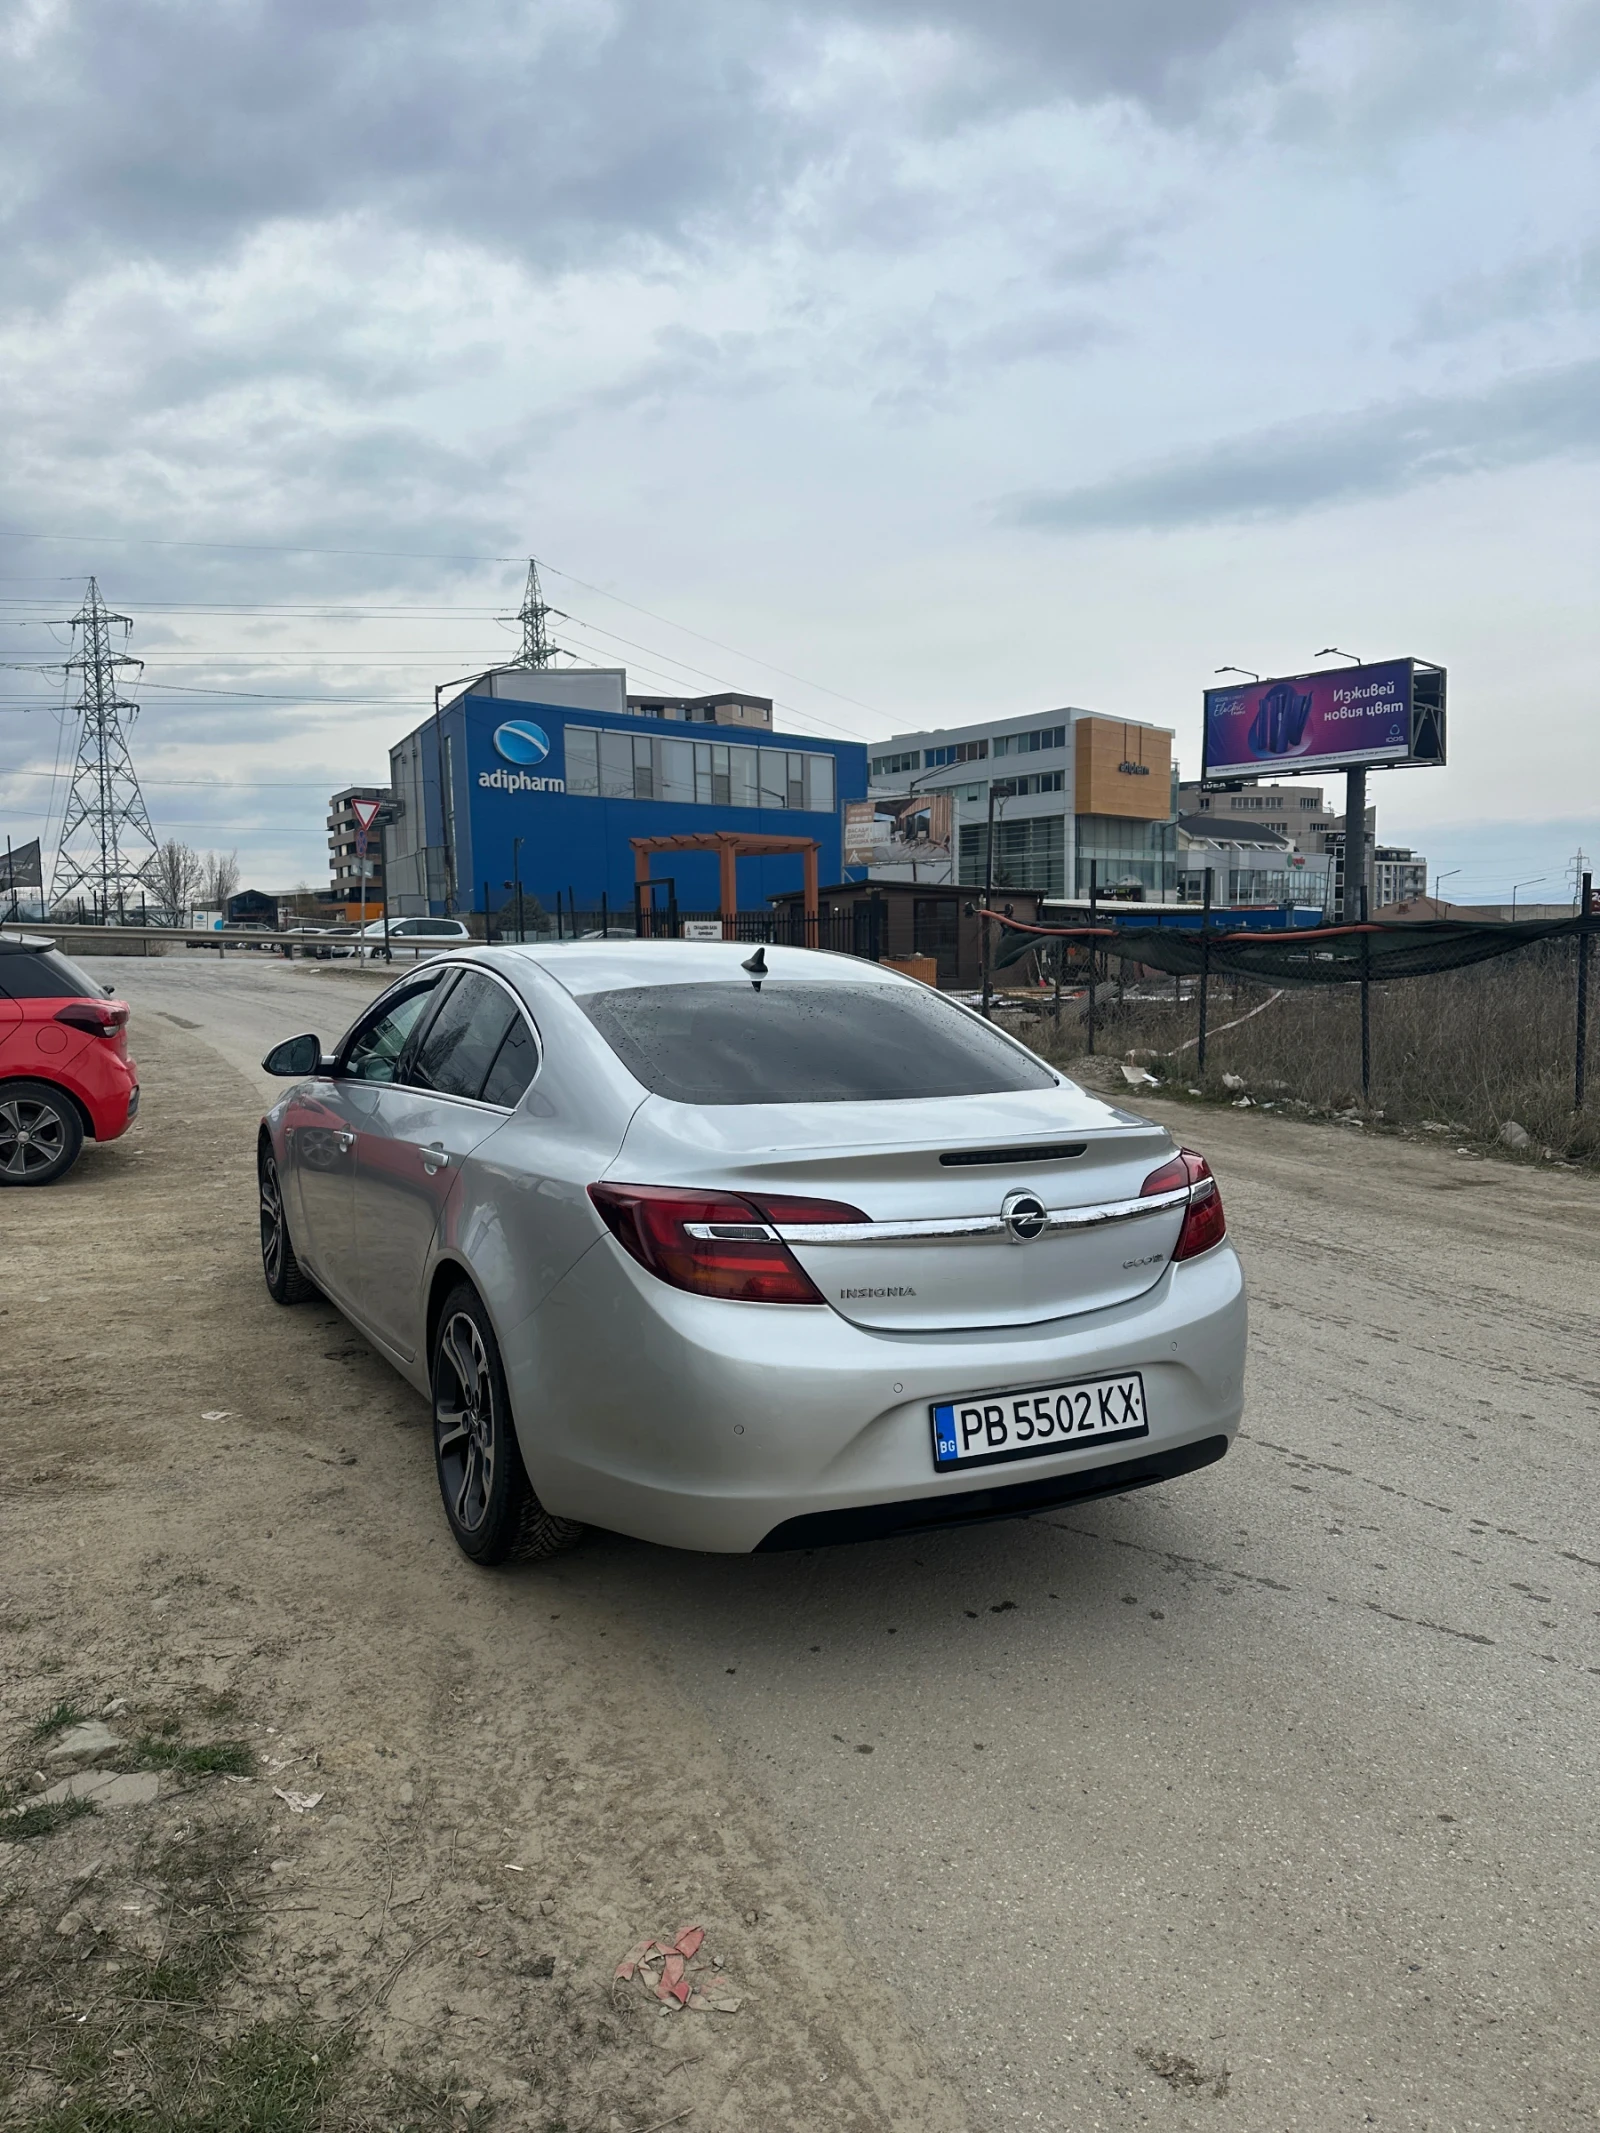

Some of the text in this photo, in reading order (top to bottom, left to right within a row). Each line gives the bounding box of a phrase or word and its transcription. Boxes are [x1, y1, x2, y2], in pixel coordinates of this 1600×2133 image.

[1333, 681, 1395, 704] Изживей
[1324, 701, 1404, 721] новия цвят
[478, 768, 565, 794] adipharm
[840, 1286, 917, 1299] INSIGNIA
[940, 1440, 955, 1453] BG
